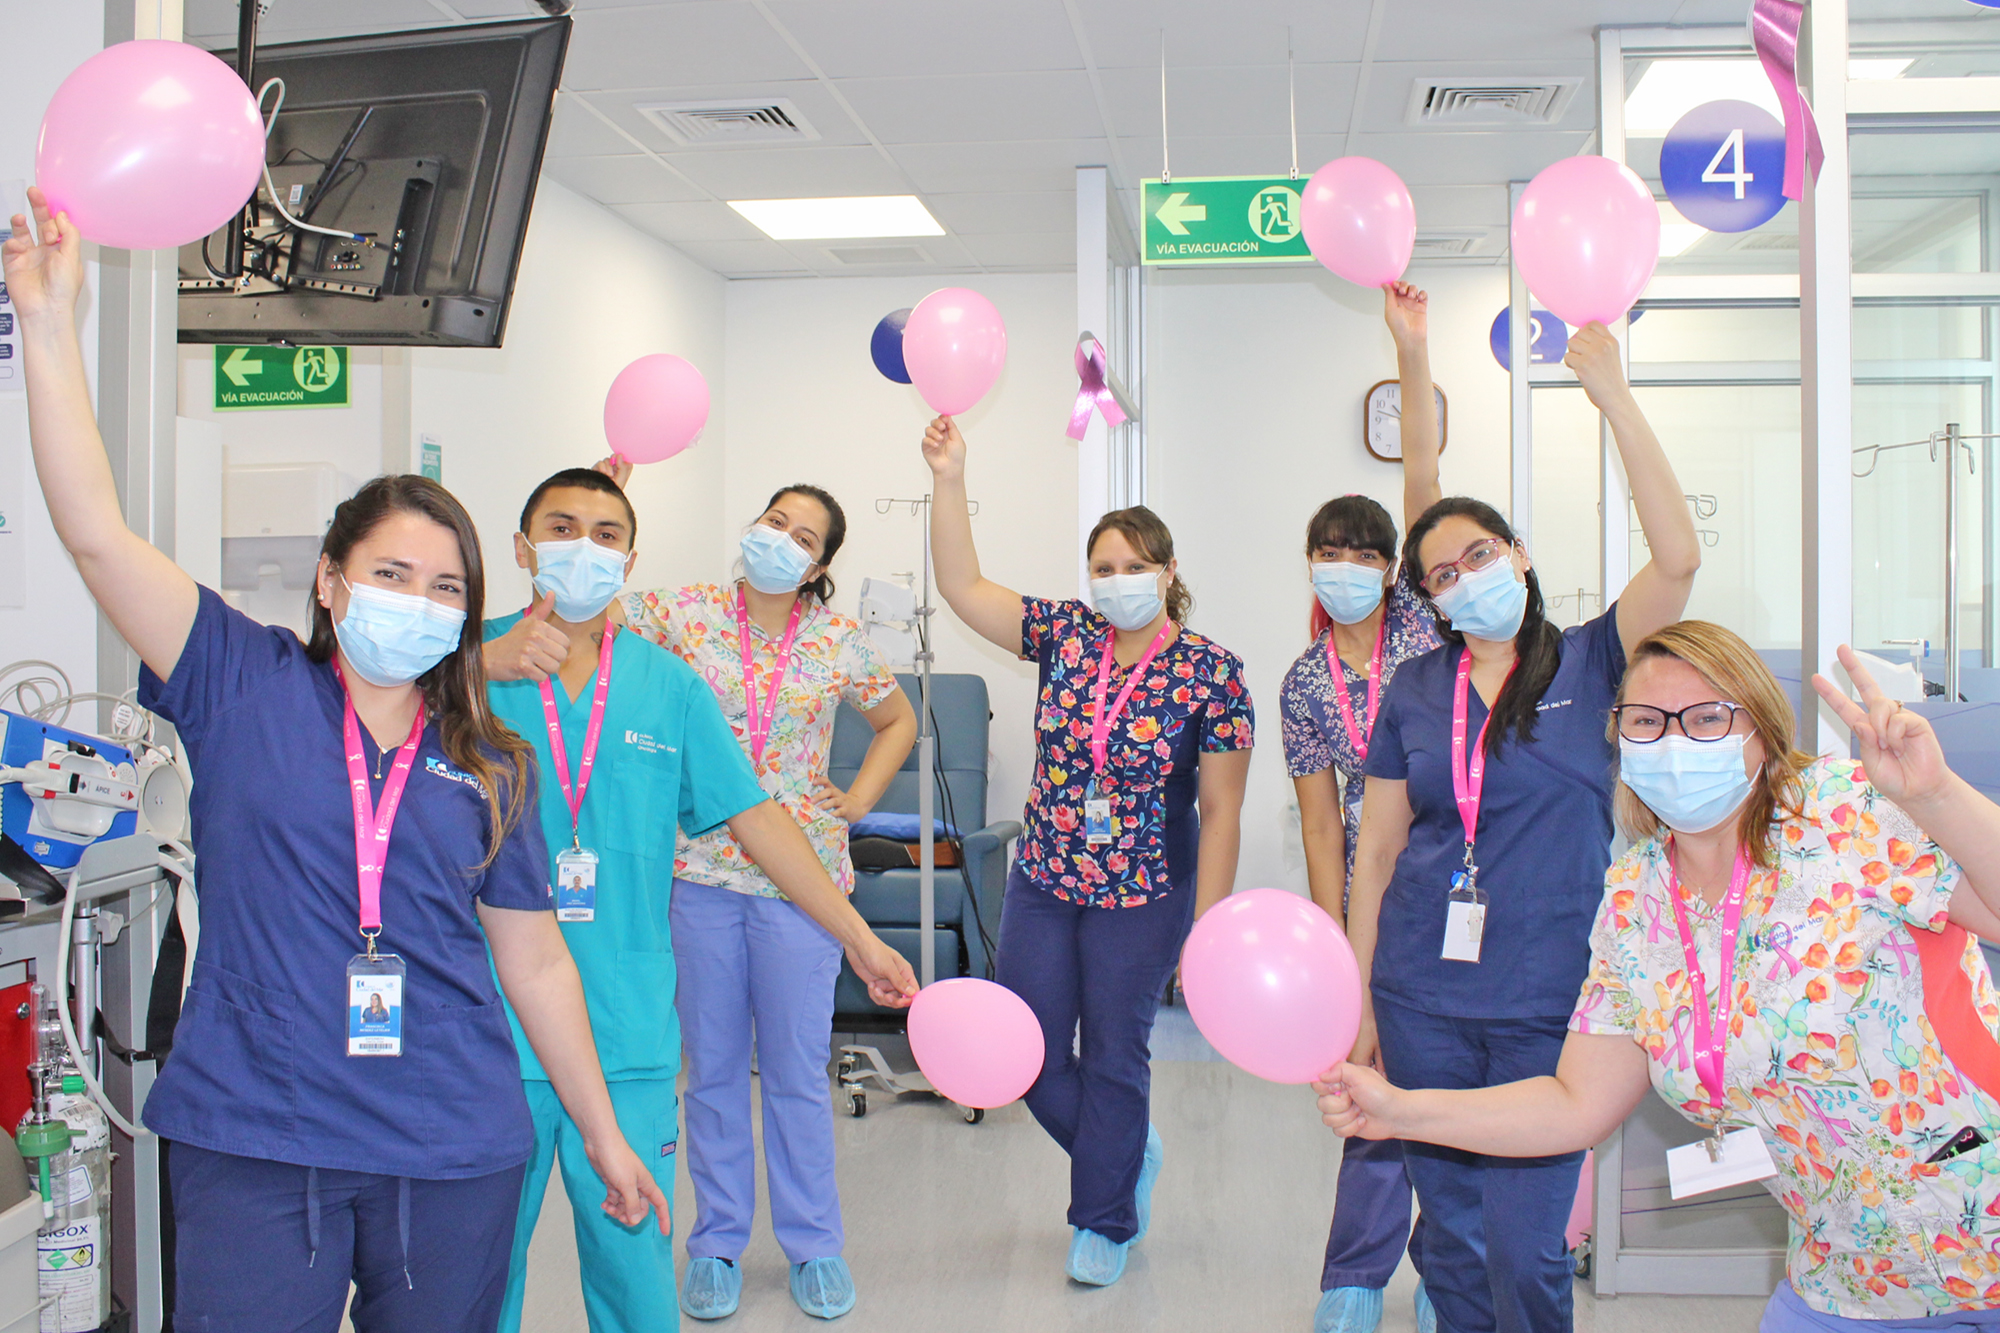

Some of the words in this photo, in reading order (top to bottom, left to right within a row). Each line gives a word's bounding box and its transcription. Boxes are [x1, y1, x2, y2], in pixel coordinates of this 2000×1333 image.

[1702, 129, 1754, 199] 4
[1156, 242, 1177, 254] VÍA
[1179, 240, 1259, 253] EVACUACIÓN
[1530, 317, 1543, 360] 2
[221, 392, 238, 402] VÍA
[240, 390, 304, 402] EVACUACIÓN
[1386, 389, 1395, 398] 11
[1376, 400, 1386, 408] 10
[1375, 416, 1382, 425] 9
[1375, 432, 1382, 441] 8
[1386, 444, 1392, 453] 7
[425, 766, 462, 782] Ciudad
[464, 778, 480, 790] del
[477, 784, 488, 800] Ma
[95, 784, 111, 794] ÁPICE
[1792, 924, 1806, 932] del
[1808, 916, 1824, 926] Mar
